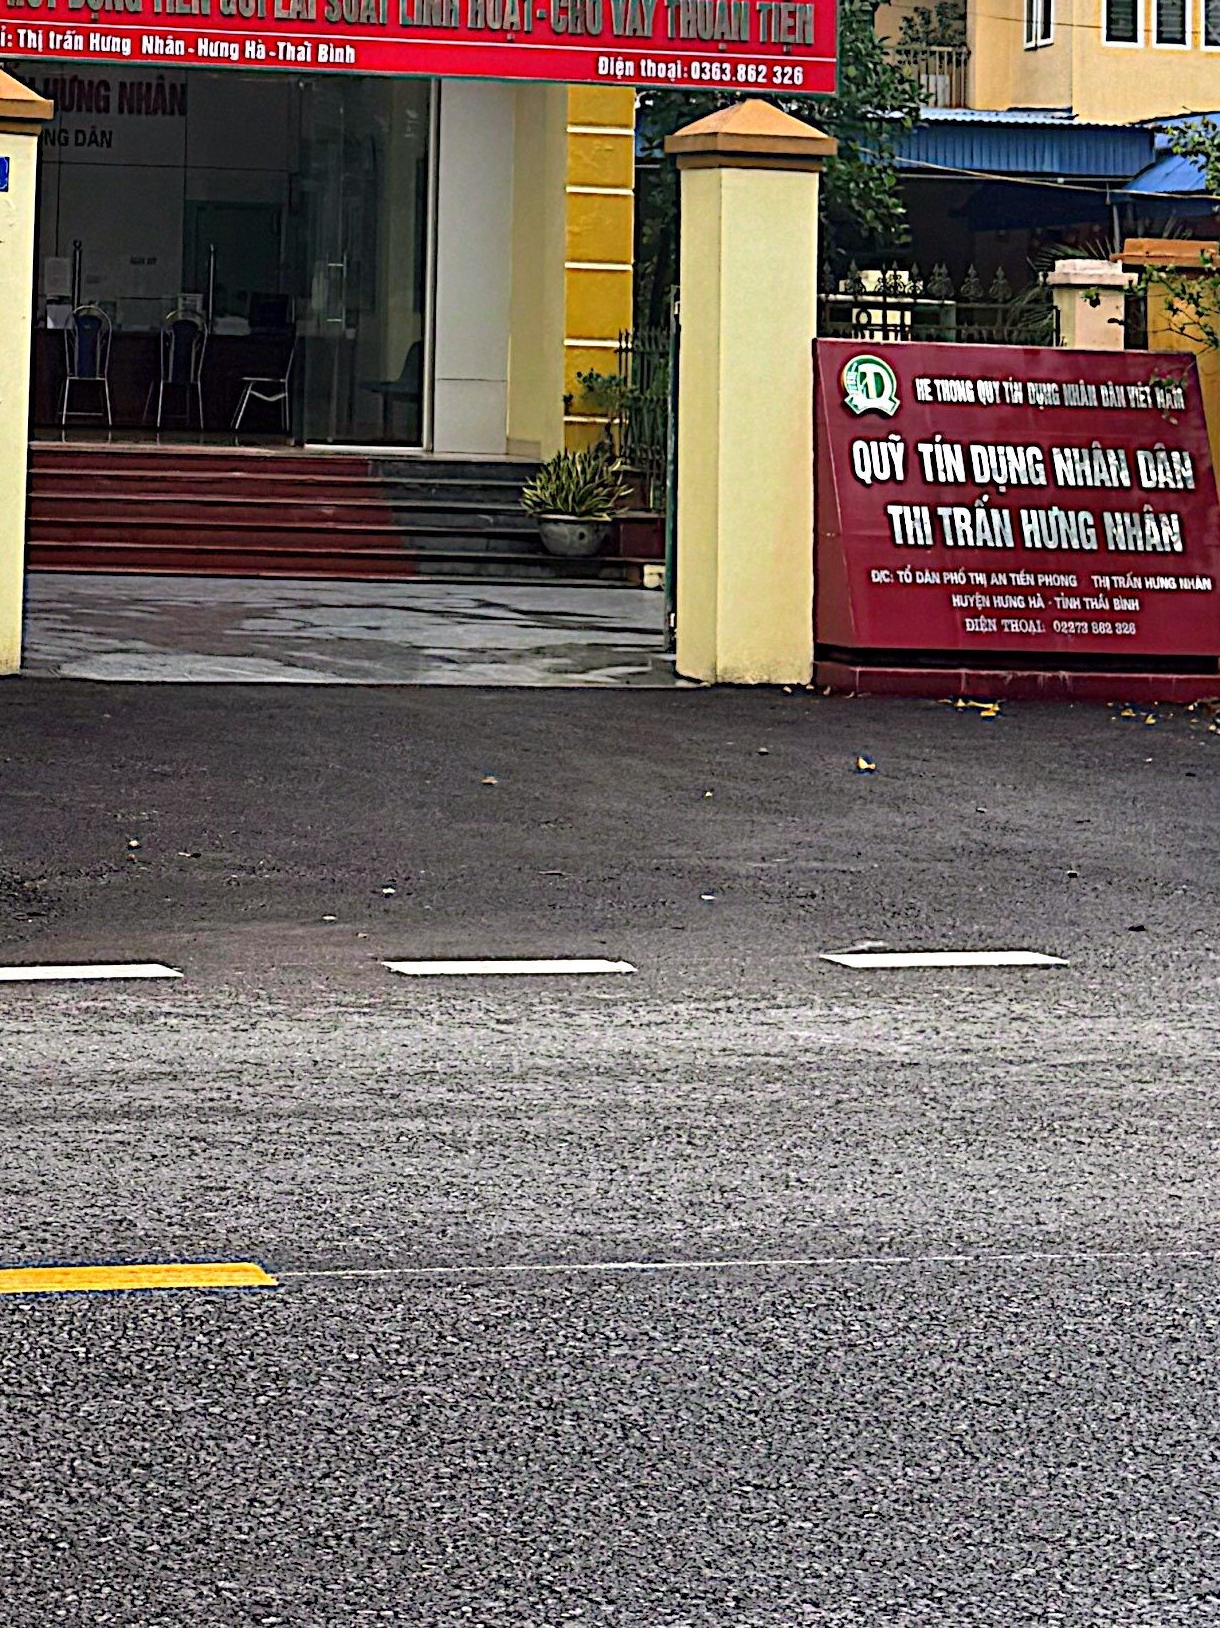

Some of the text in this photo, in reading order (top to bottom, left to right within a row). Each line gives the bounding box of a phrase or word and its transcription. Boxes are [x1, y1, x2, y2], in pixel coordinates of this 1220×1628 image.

[17, 29, 43, 52] Thị
[49, 30, 84, 50] trấn
[89, 32, 131, 56] Hưng
[245, 39, 266, 59] Hà
[318, 43, 356, 63] Bình
[597, 56, 634, 79] Điện
[772, 66, 803, 85] 326
[118, 74, 187, 116] NHÂN
[852, 434, 1195, 492] QUỸ TÍN DỤNG NHÂN DÂN
[937, 494, 1015, 548] TRẤN
[1020, 506, 1098, 550] HƯNG
[1103, 504, 1183, 552] NHÂN
[896, 564, 913, 583] TỔ
[968, 571, 987, 588] THỊ
[990, 572, 1007, 585] AN
[1037, 574, 1078, 587] PHONG
[1091, 575, 1110, 591] THỊ
[1028, 593, 1045, 609] HÀ
[1053, 620, 1088, 634] 02273
